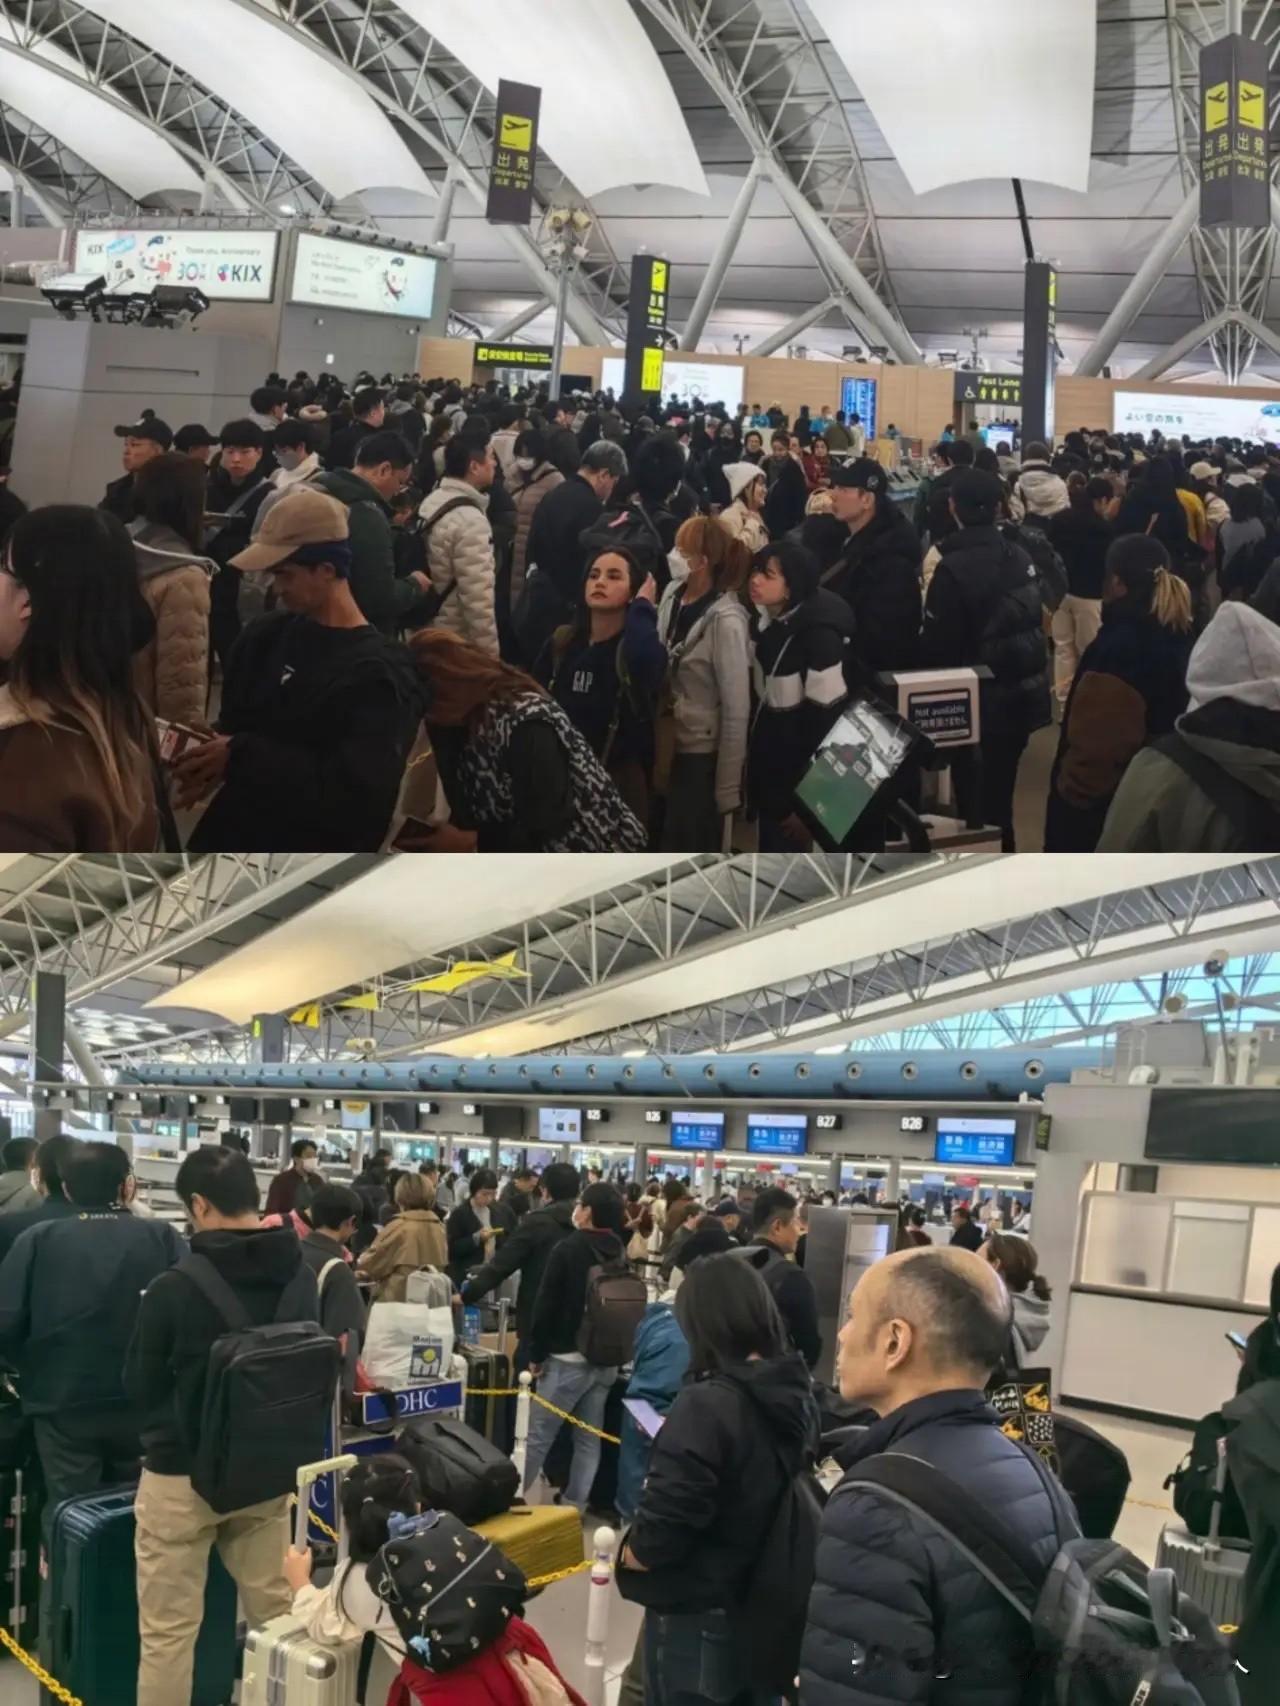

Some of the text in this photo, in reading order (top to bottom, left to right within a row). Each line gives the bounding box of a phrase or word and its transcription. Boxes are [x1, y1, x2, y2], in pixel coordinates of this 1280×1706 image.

[1237, 132, 1265, 156] 出発
[497, 152, 529, 171] 出発
[87, 243, 104, 255] KIX
[231, 264, 263, 282] KIX
[977, 376, 1020, 387] Fast Lane
[572, 670, 594, 693] GAP
[914, 707, 929, 717] Not
[816, 1114, 837, 1128] B27
[901, 1116, 923, 1130] B28
[395, 1388, 438, 1414] DHC
